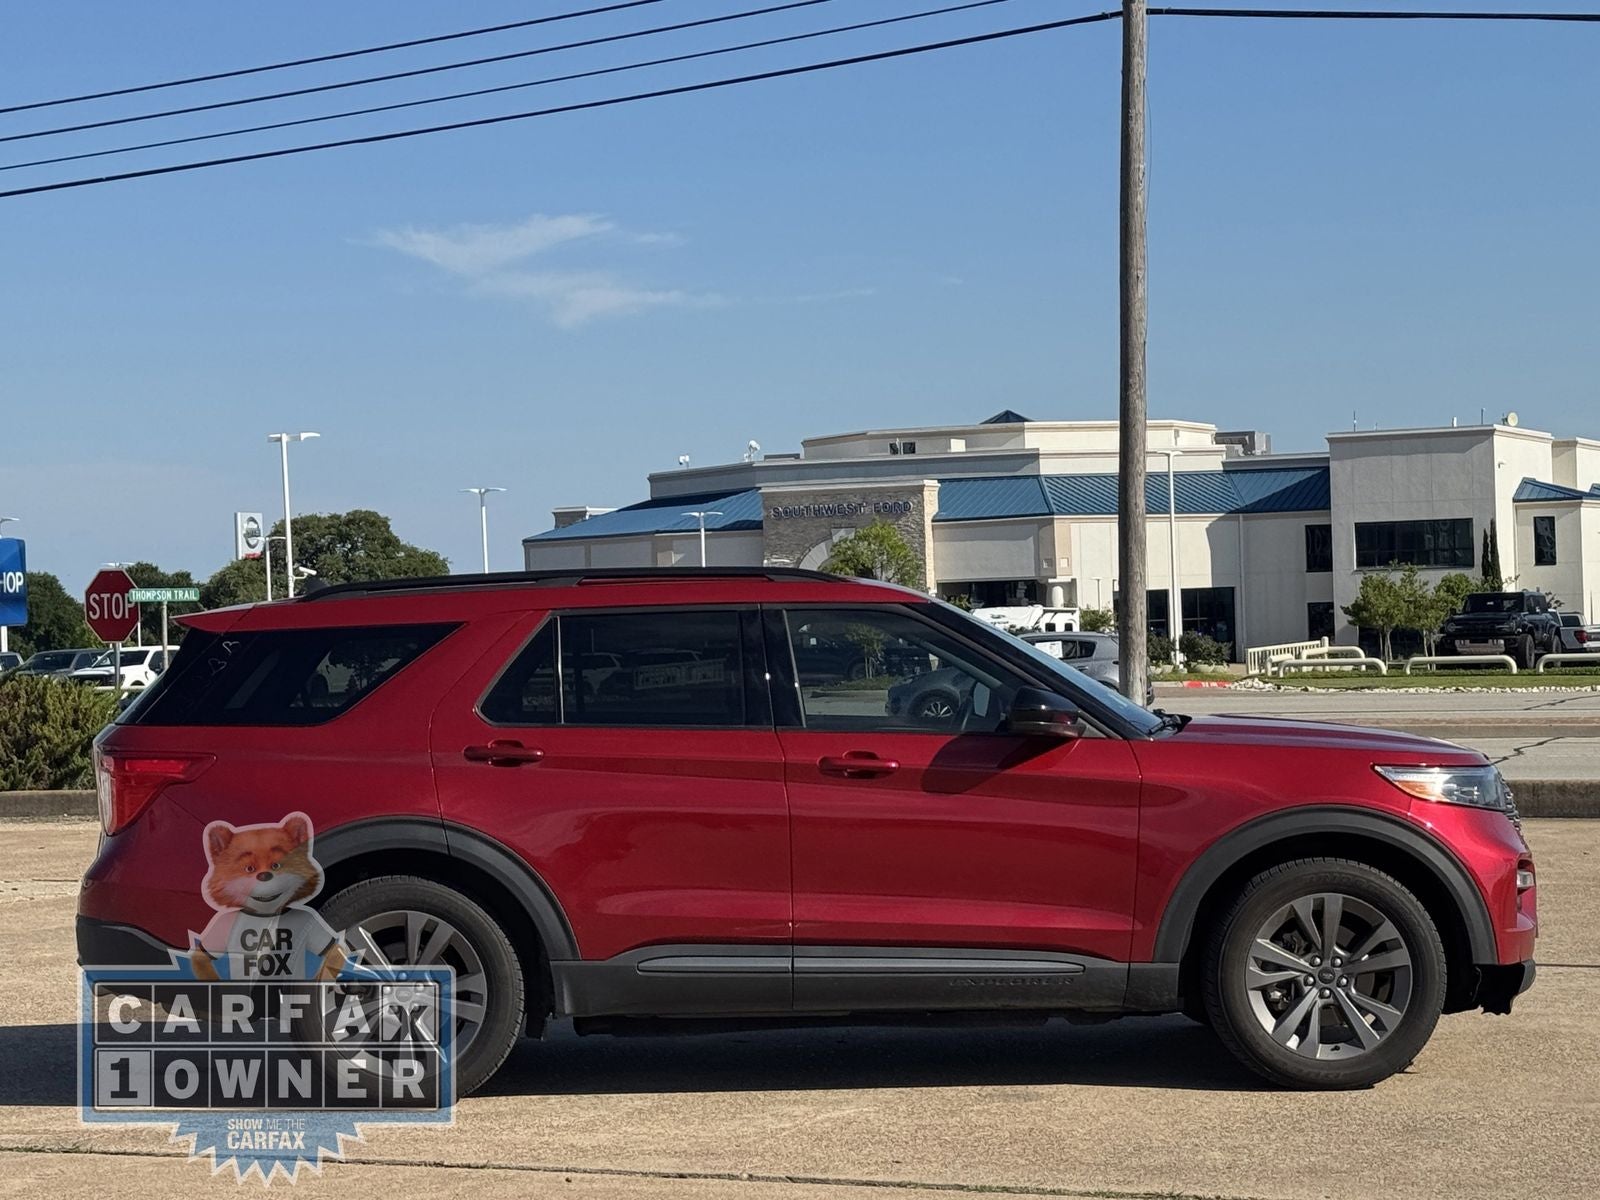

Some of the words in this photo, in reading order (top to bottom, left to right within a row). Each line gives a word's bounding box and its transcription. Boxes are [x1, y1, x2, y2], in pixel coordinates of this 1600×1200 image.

[772, 502, 866, 518] SOUTHWEST
[873, 501, 912, 514] FORD
[131, 590, 172, 601] THOMPSON
[174, 590, 197, 601] TRAIL
[89, 592, 136, 620] STOP
